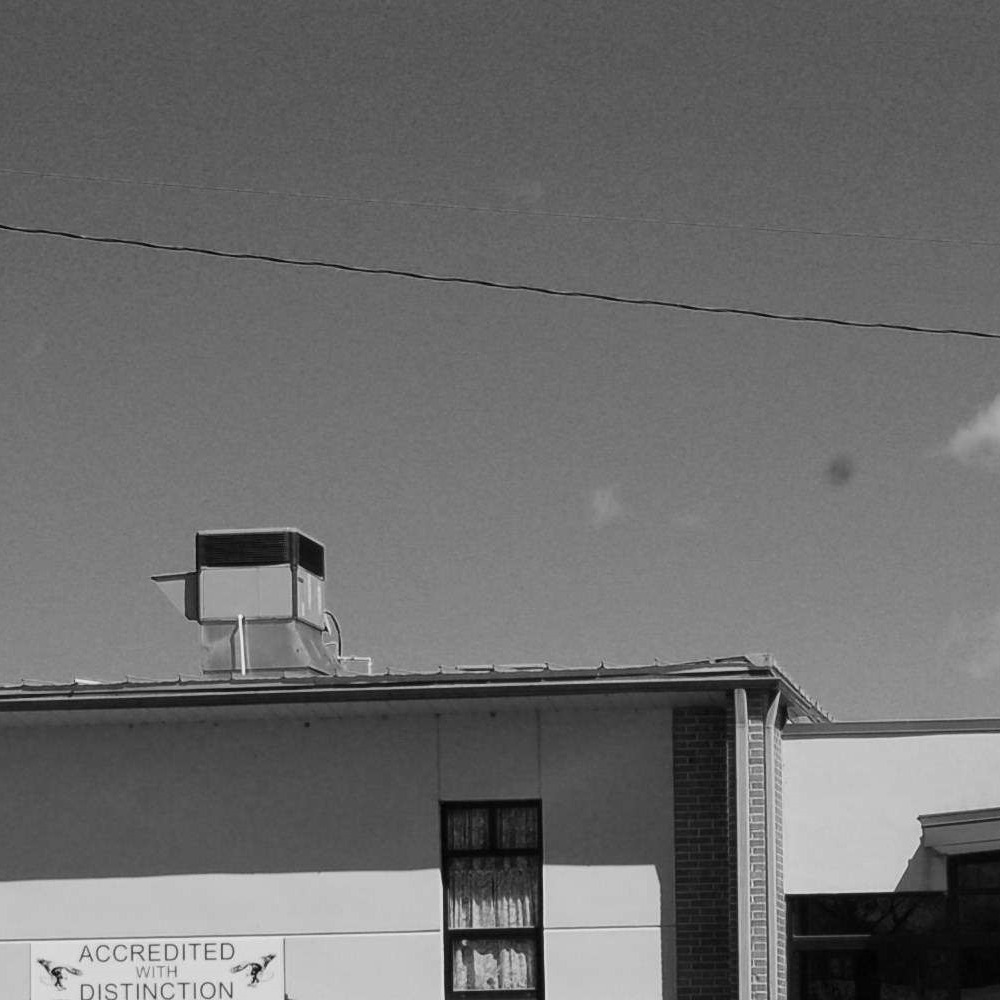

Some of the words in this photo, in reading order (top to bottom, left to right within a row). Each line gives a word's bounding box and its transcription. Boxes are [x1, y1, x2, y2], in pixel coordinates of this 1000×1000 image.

[79, 942, 236, 962] ACCREDITED
[136, 965, 178, 978] WITH
[80, 981, 234, 1000] DISTINCTION
